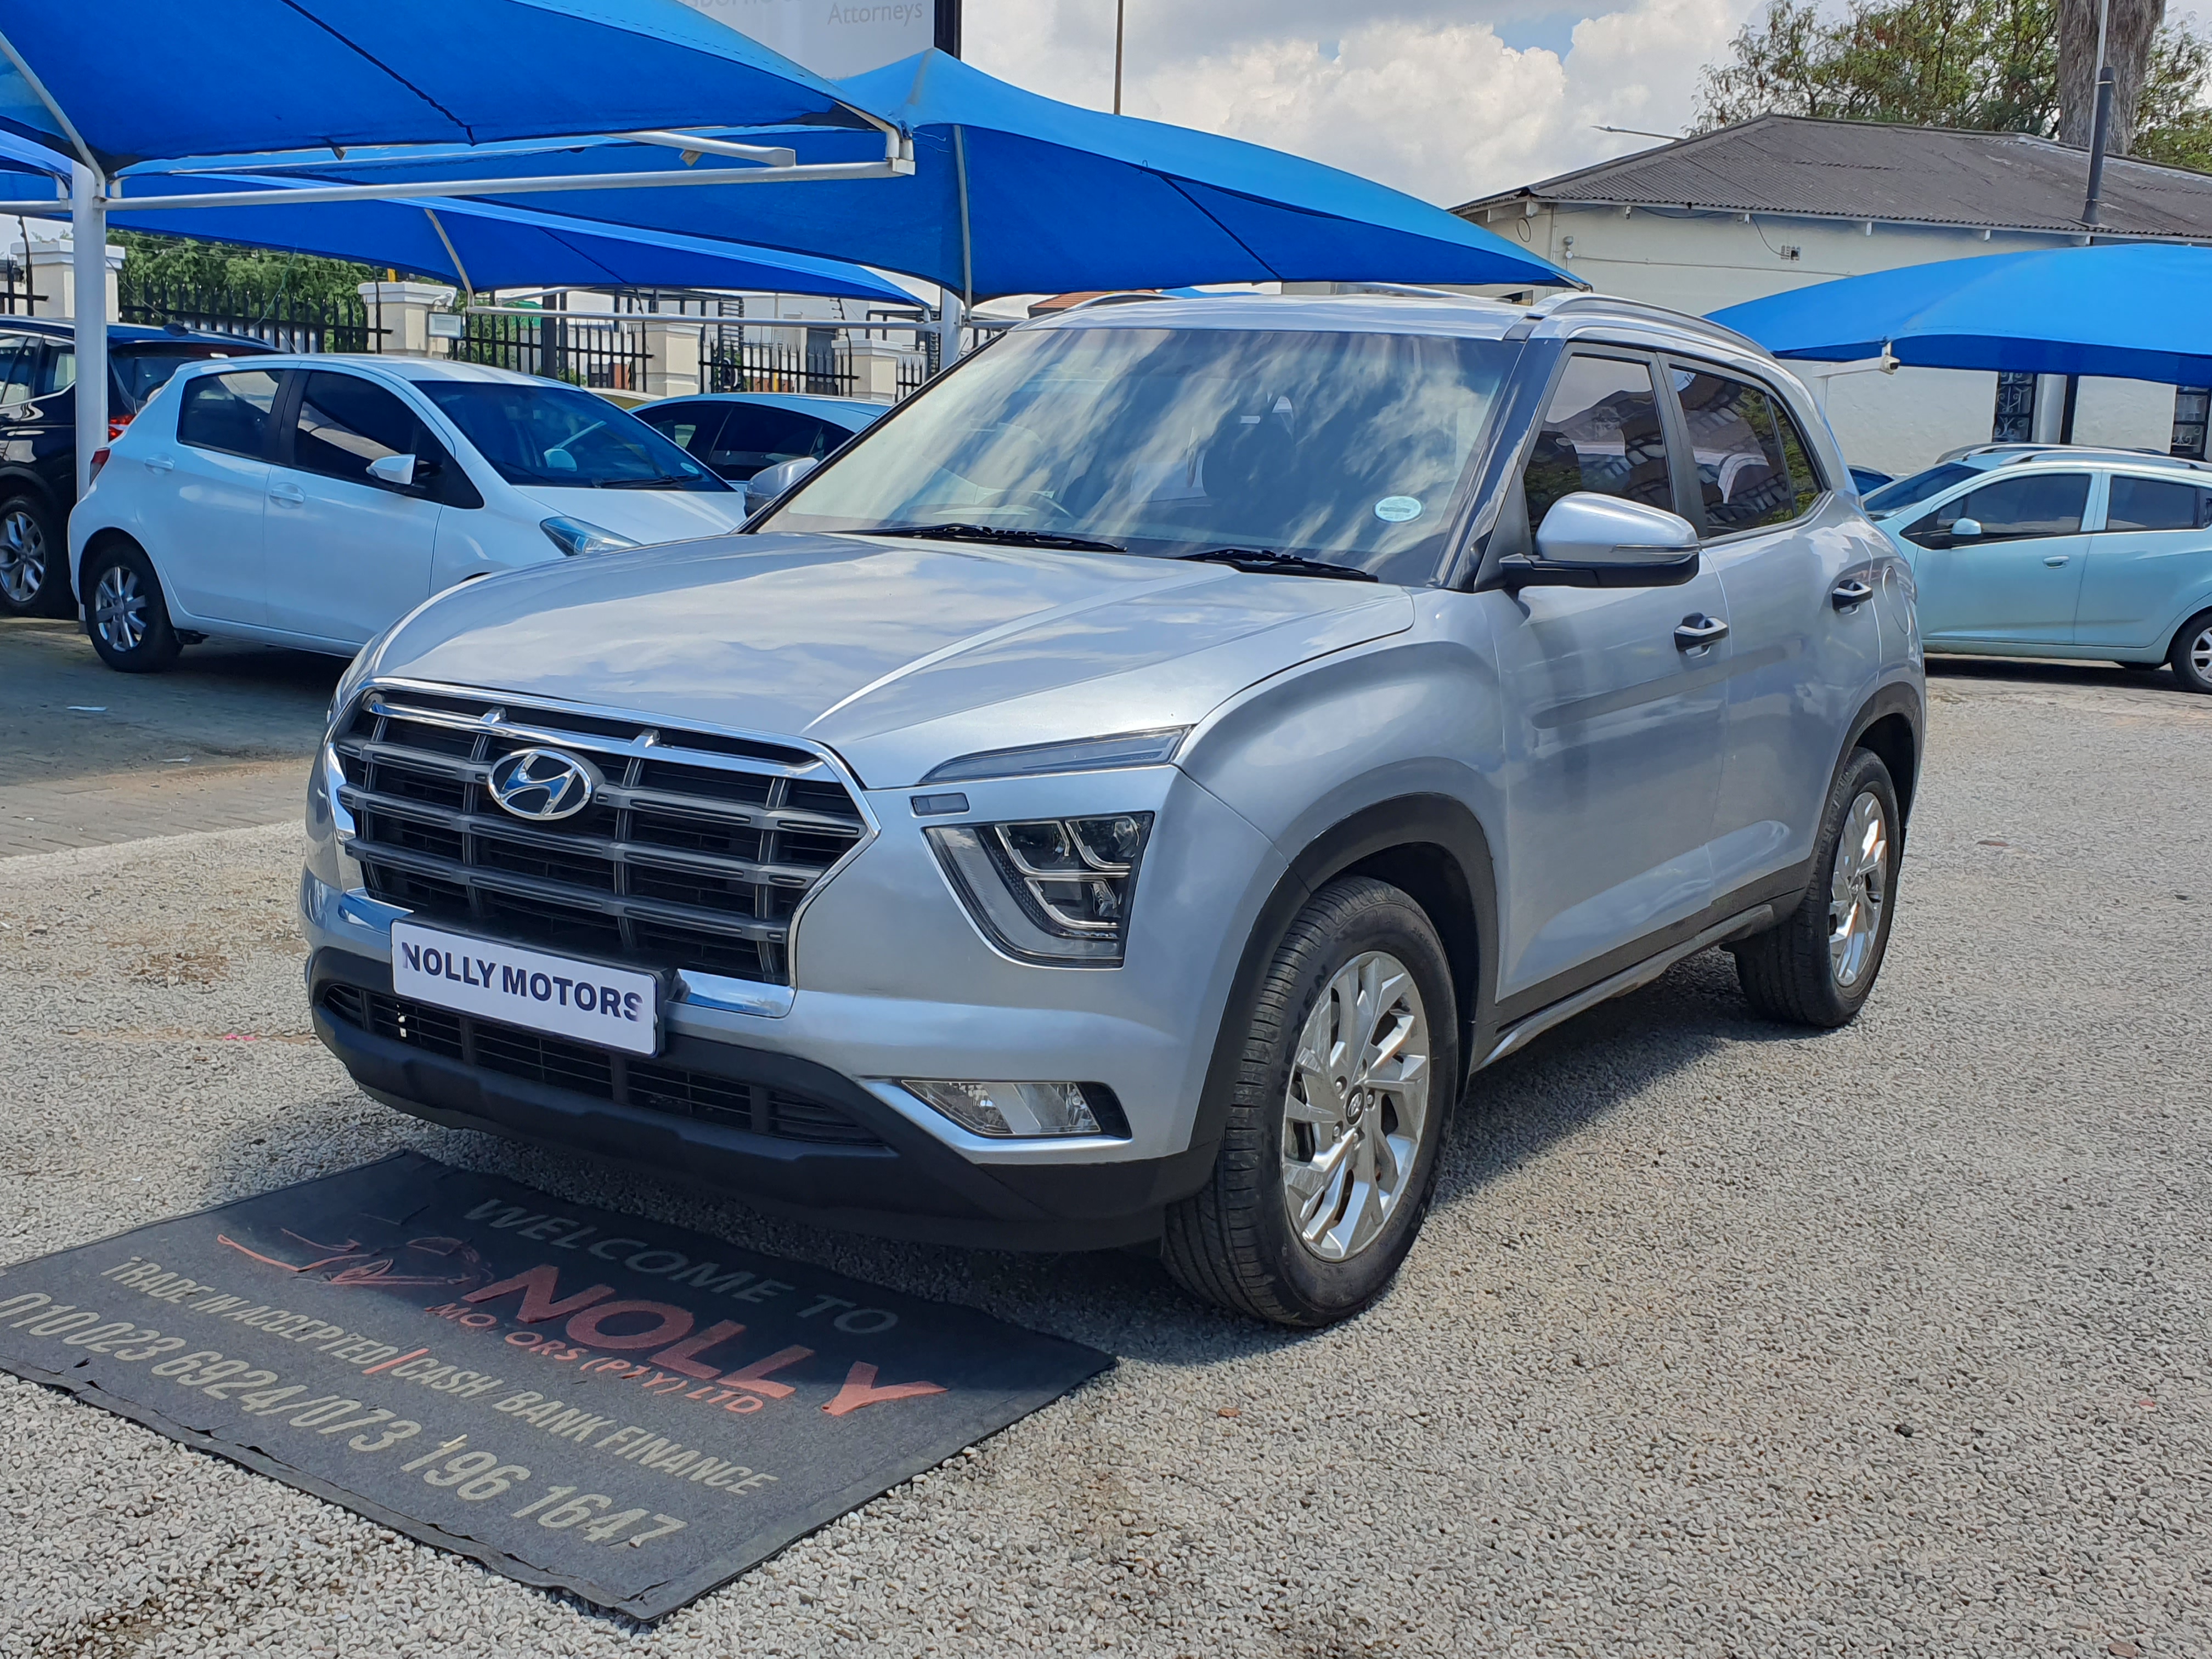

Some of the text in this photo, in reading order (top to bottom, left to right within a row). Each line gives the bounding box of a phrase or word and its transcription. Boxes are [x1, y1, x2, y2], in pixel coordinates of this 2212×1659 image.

[827, 2, 923, 27] Attorneys
[401, 941, 644, 1023] NOLLY MOTORS
[462, 1198, 899, 1334] WELCOME TO
[100, 1256, 216, 1304] TRADE
[188, 1293, 251, 1314] IN
[493, 1391, 617, 1442] BANK
[592, 1425, 779, 1496] FINANCE
[424, 1302, 764, 1414] MOORS (PTY) LTD
[461, 1263, 950, 1416] NOLLY
[0, 1293, 101, 1336] 010
[62, 1322, 187, 1361] 023
[399, 1440, 532, 1500] 196
[510, 1486, 689, 1548] 1647
